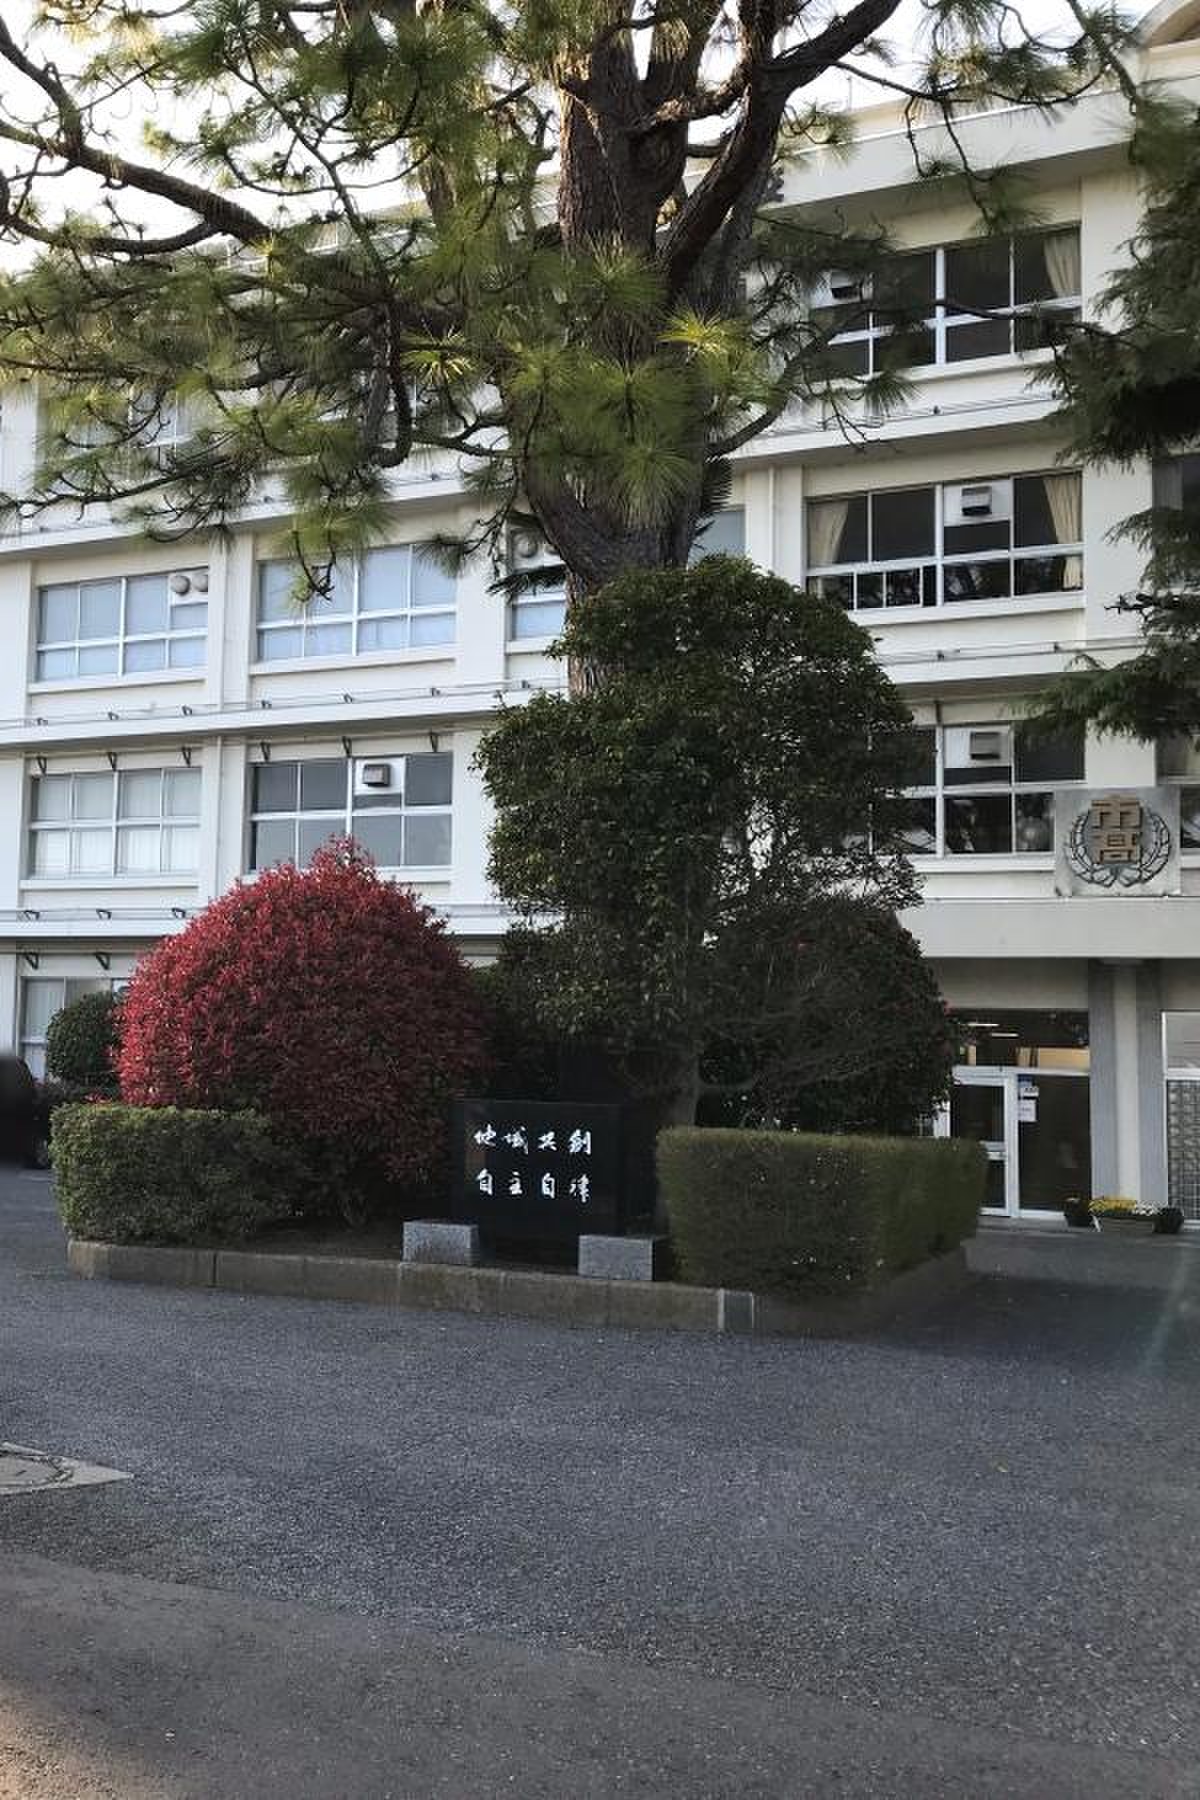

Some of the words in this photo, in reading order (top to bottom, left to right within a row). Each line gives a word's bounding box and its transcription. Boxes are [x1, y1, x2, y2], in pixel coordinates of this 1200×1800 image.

[473, 1124, 592, 1155] 地域共創
[476, 1169, 590, 1203] 自主自律
